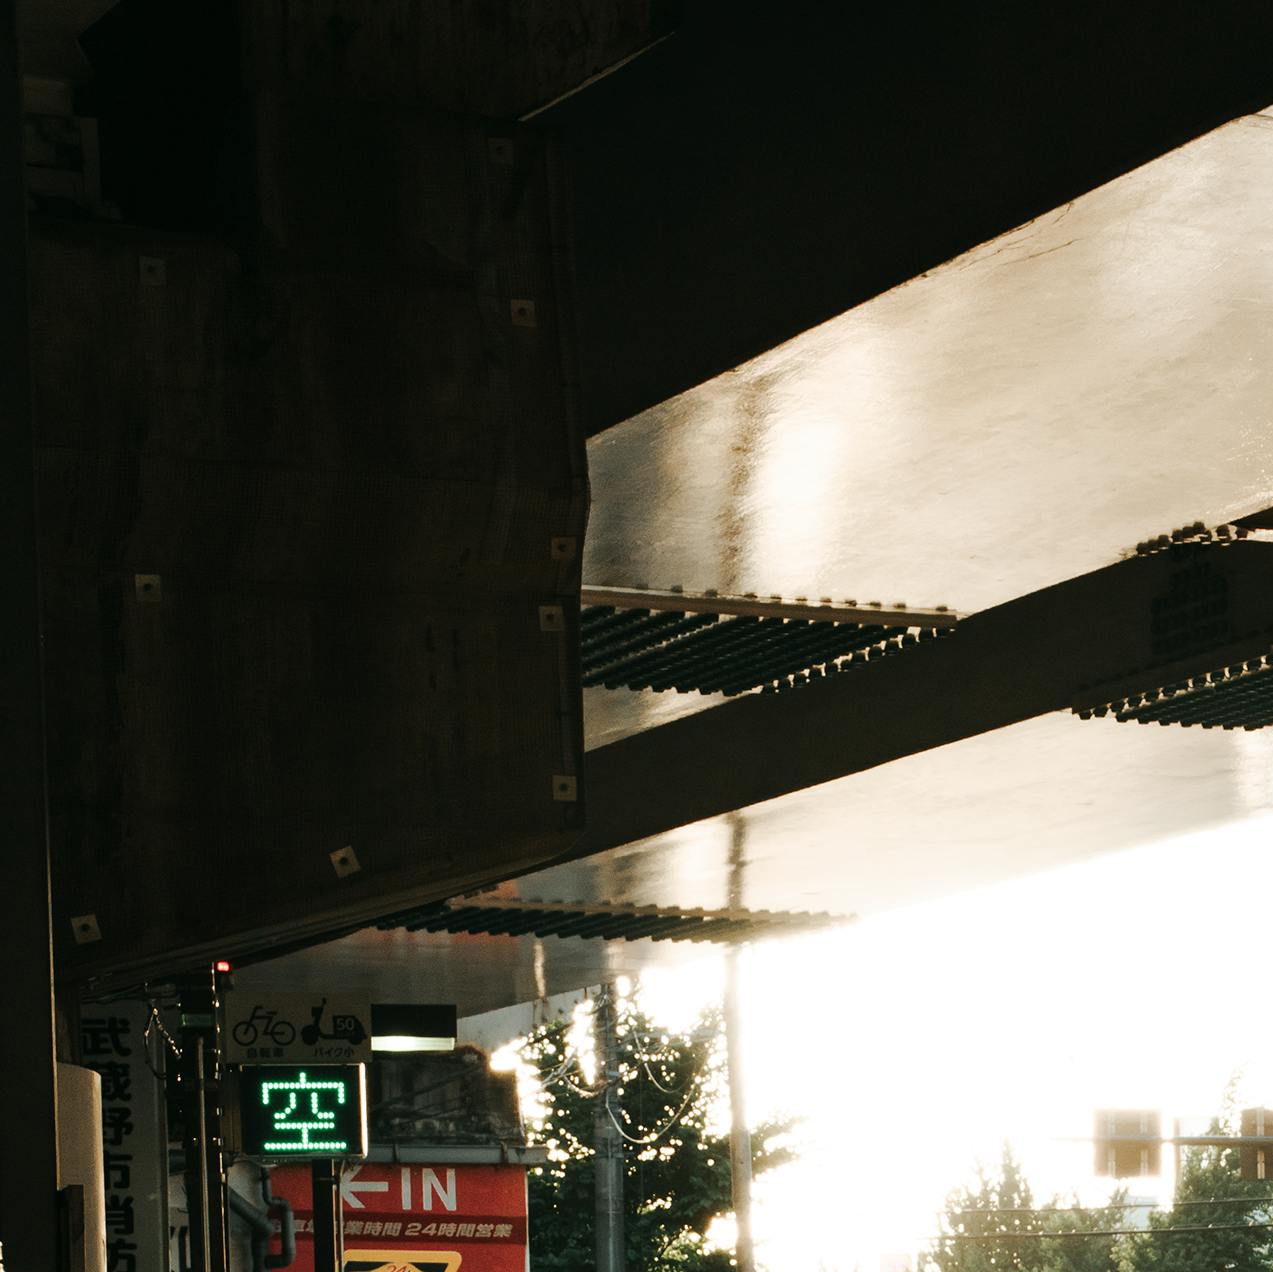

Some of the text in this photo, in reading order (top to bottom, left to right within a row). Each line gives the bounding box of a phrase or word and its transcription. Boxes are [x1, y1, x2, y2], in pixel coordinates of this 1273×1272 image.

[336, 1017, 355, 1031] 50
[261, 1070, 348, 1150] 空
[401, 1167, 458, 1212] IN
[404, 1222, 514, 1238] 24時間営業
